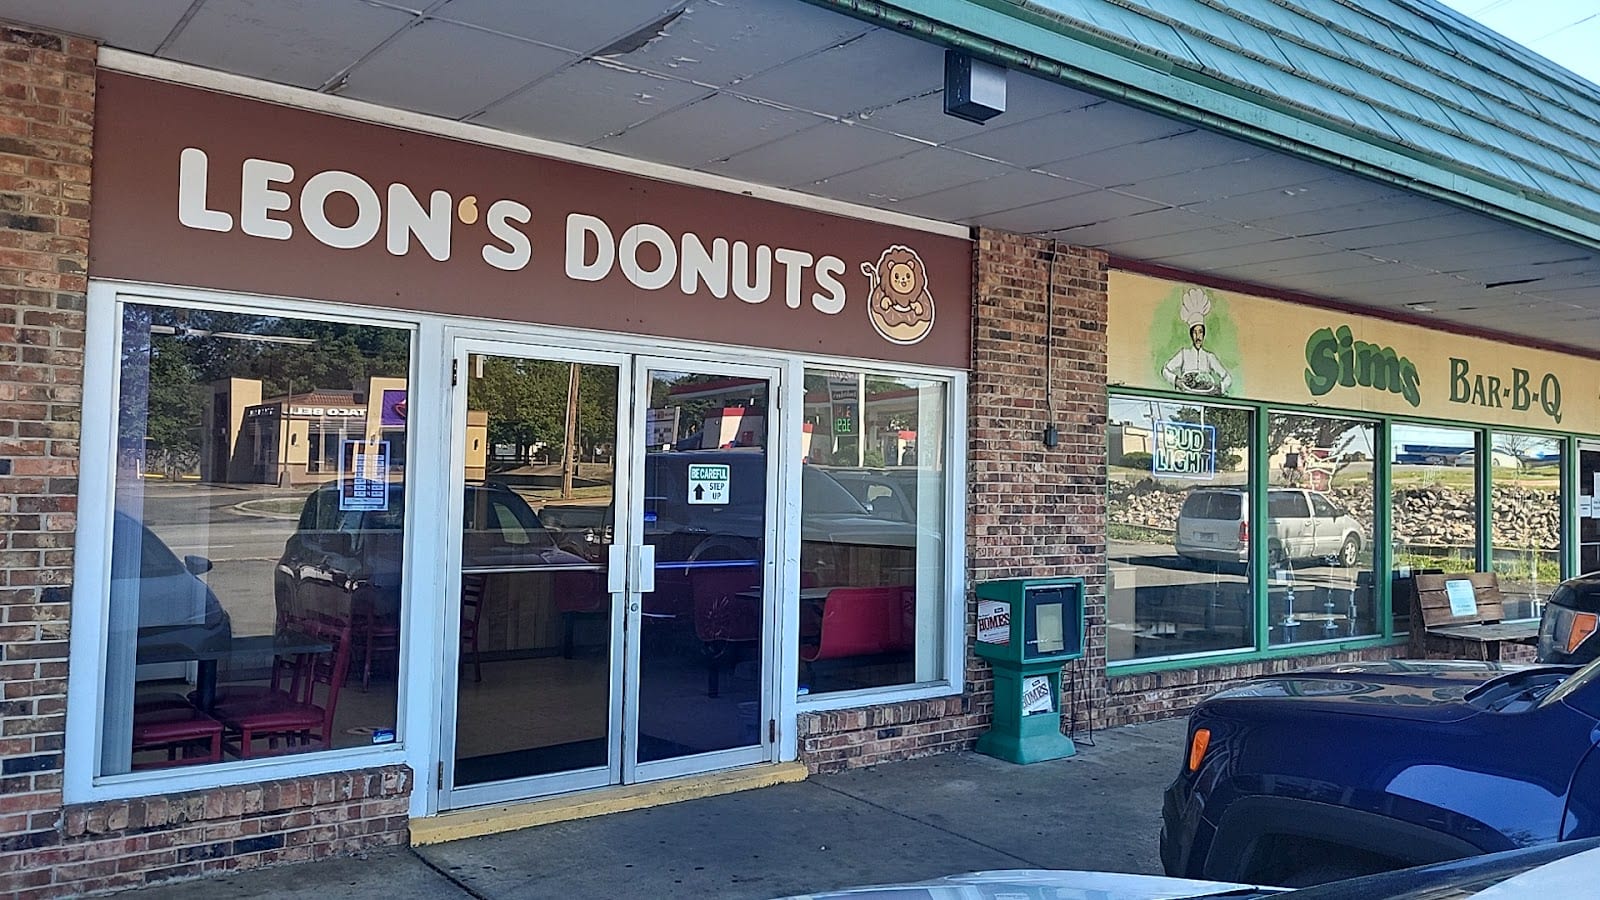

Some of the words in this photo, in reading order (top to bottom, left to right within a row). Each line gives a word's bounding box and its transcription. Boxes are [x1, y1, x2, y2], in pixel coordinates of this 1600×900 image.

[179, 147, 532, 271] LEON'S
[565, 213, 846, 315] DONUTS
[1304, 325, 1421, 408] Sims
[1164, 425, 1204, 451] BUD
[1156, 448, 1211, 473] LIGHT
[691, 468, 699, 479] BE
[700, 468, 727, 480] CAREFUL
[709, 482, 725, 491] STEP
[712, 492, 722, 500] UP
[978, 613, 1010, 631] HOMES
